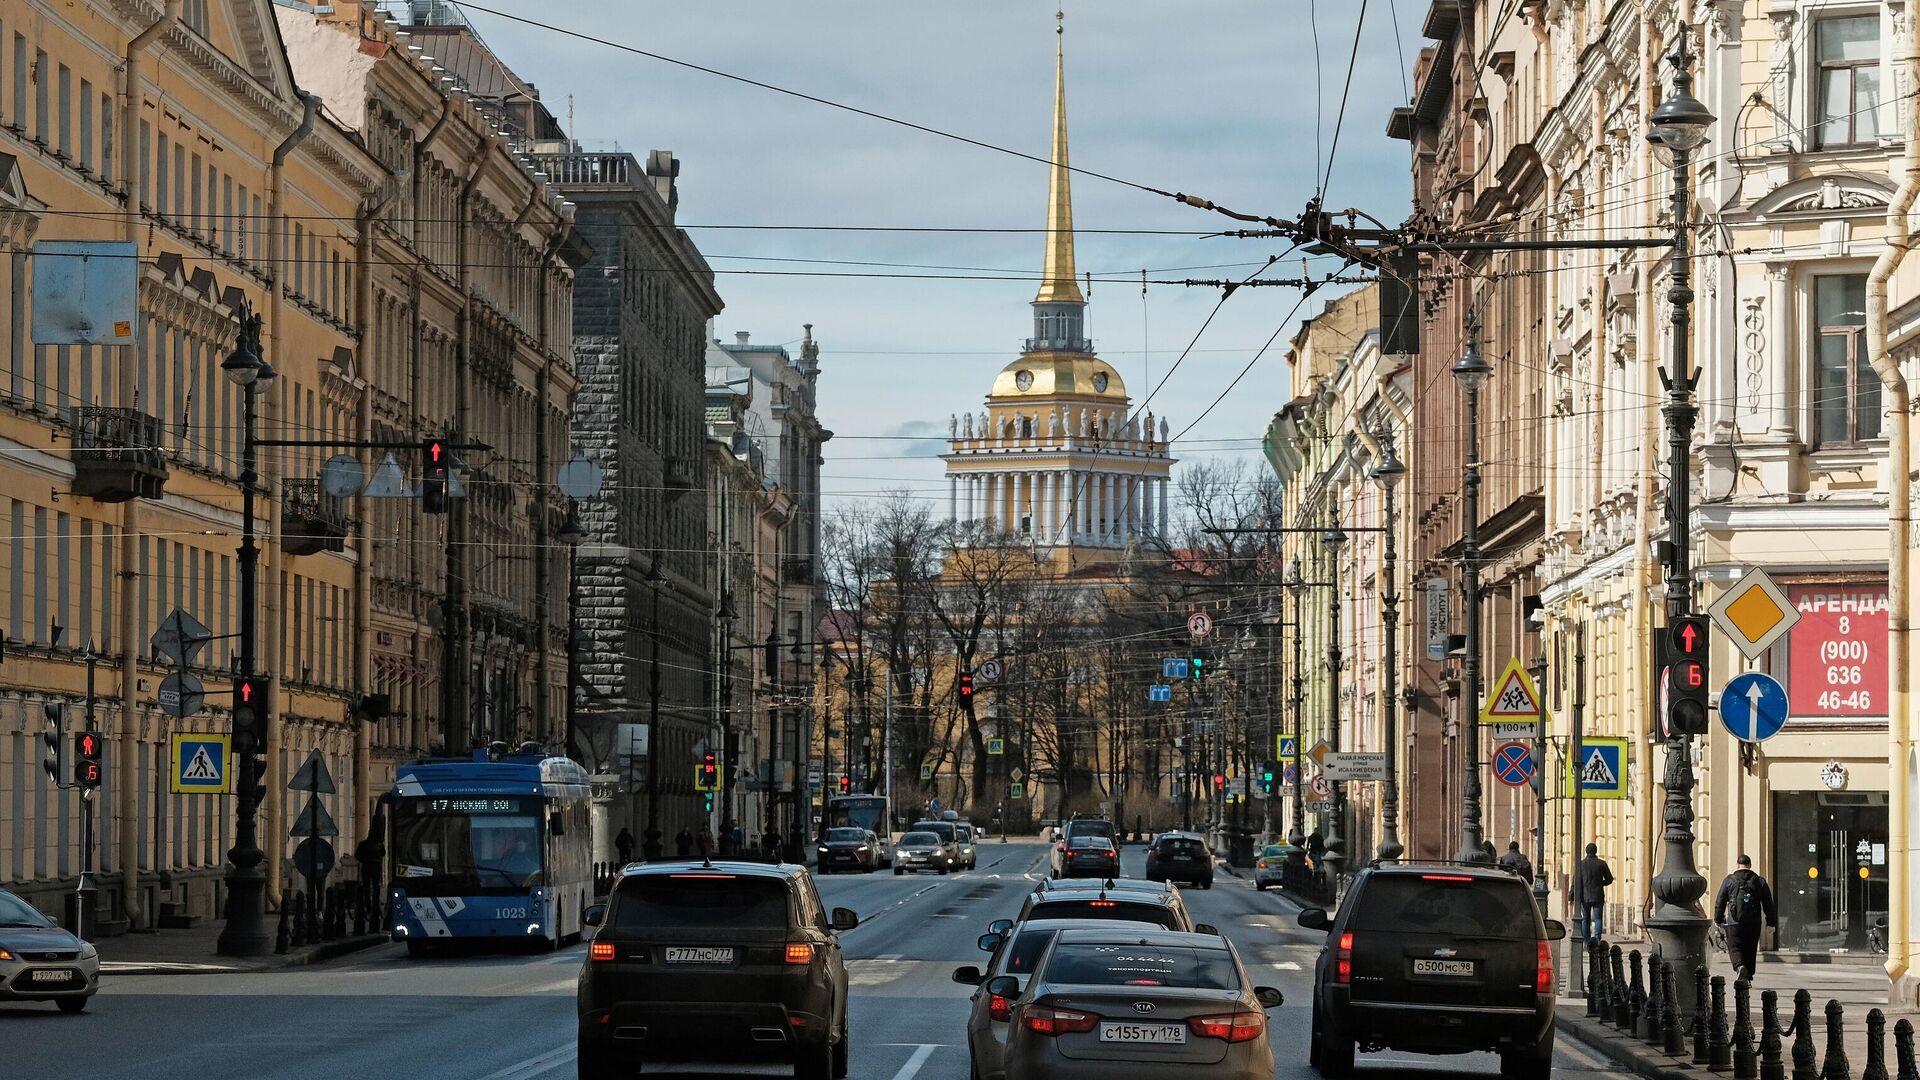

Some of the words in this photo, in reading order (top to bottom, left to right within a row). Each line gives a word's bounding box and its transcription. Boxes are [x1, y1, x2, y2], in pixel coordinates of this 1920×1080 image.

[1798, 593, 1889, 615] АРЕНДА
[1839, 616, 1850, 635] 8
[1820, 640, 1868, 665] (900)
[1689, 665, 1701, 685] 6
[1827, 666, 1861, 685] 636
[1817, 691, 1870, 710] 46-46
[88, 765, 97, 780] 6
[431, 800, 448, 810] 17
[495, 908, 526, 919] 1023
[714, 949, 730, 957] 777
[1460, 962, 1471, 971] 98
[1136, 1003, 1151, 1011] KIA
[1160, 1026, 1180, 1037] 178
